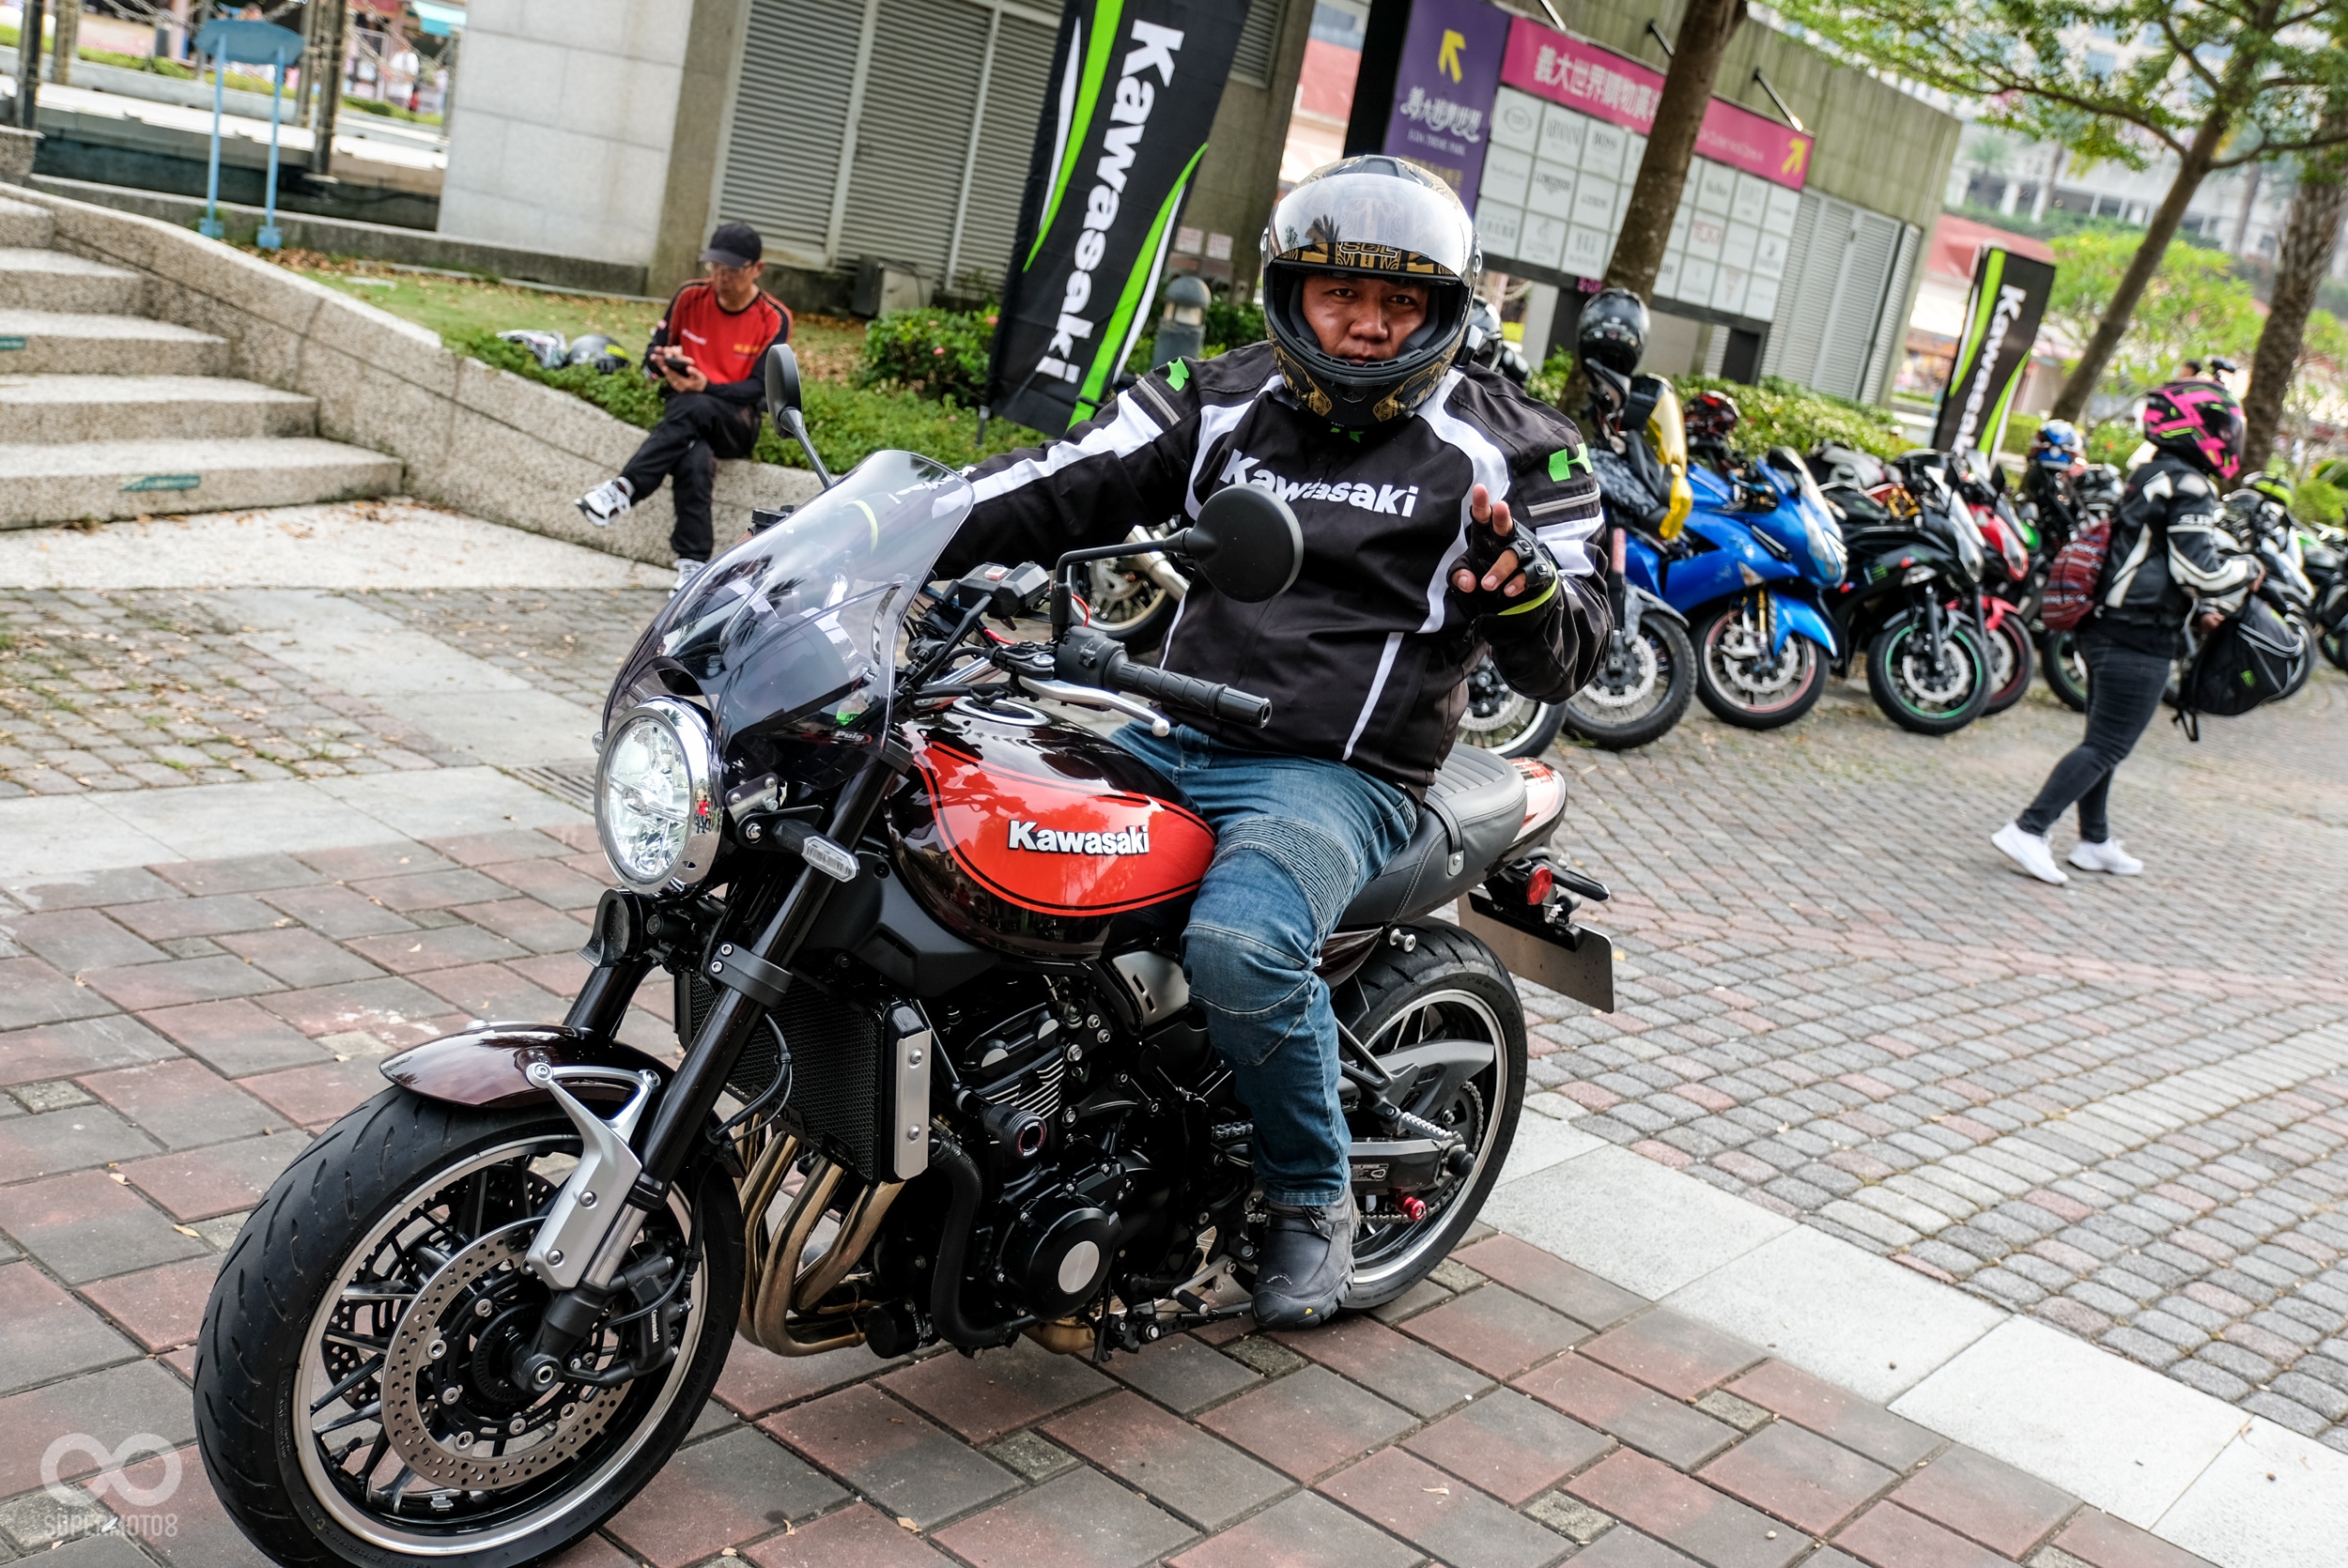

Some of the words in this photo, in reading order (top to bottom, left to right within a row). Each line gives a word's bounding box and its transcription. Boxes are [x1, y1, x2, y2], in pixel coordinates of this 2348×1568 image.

[1035, 19, 1184, 384] Kawasaki
[1951, 284, 2027, 458] Kawasak
[1219, 449, 1419, 517] Kawasaki
[1008, 820, 1151, 855] Kawasaki
